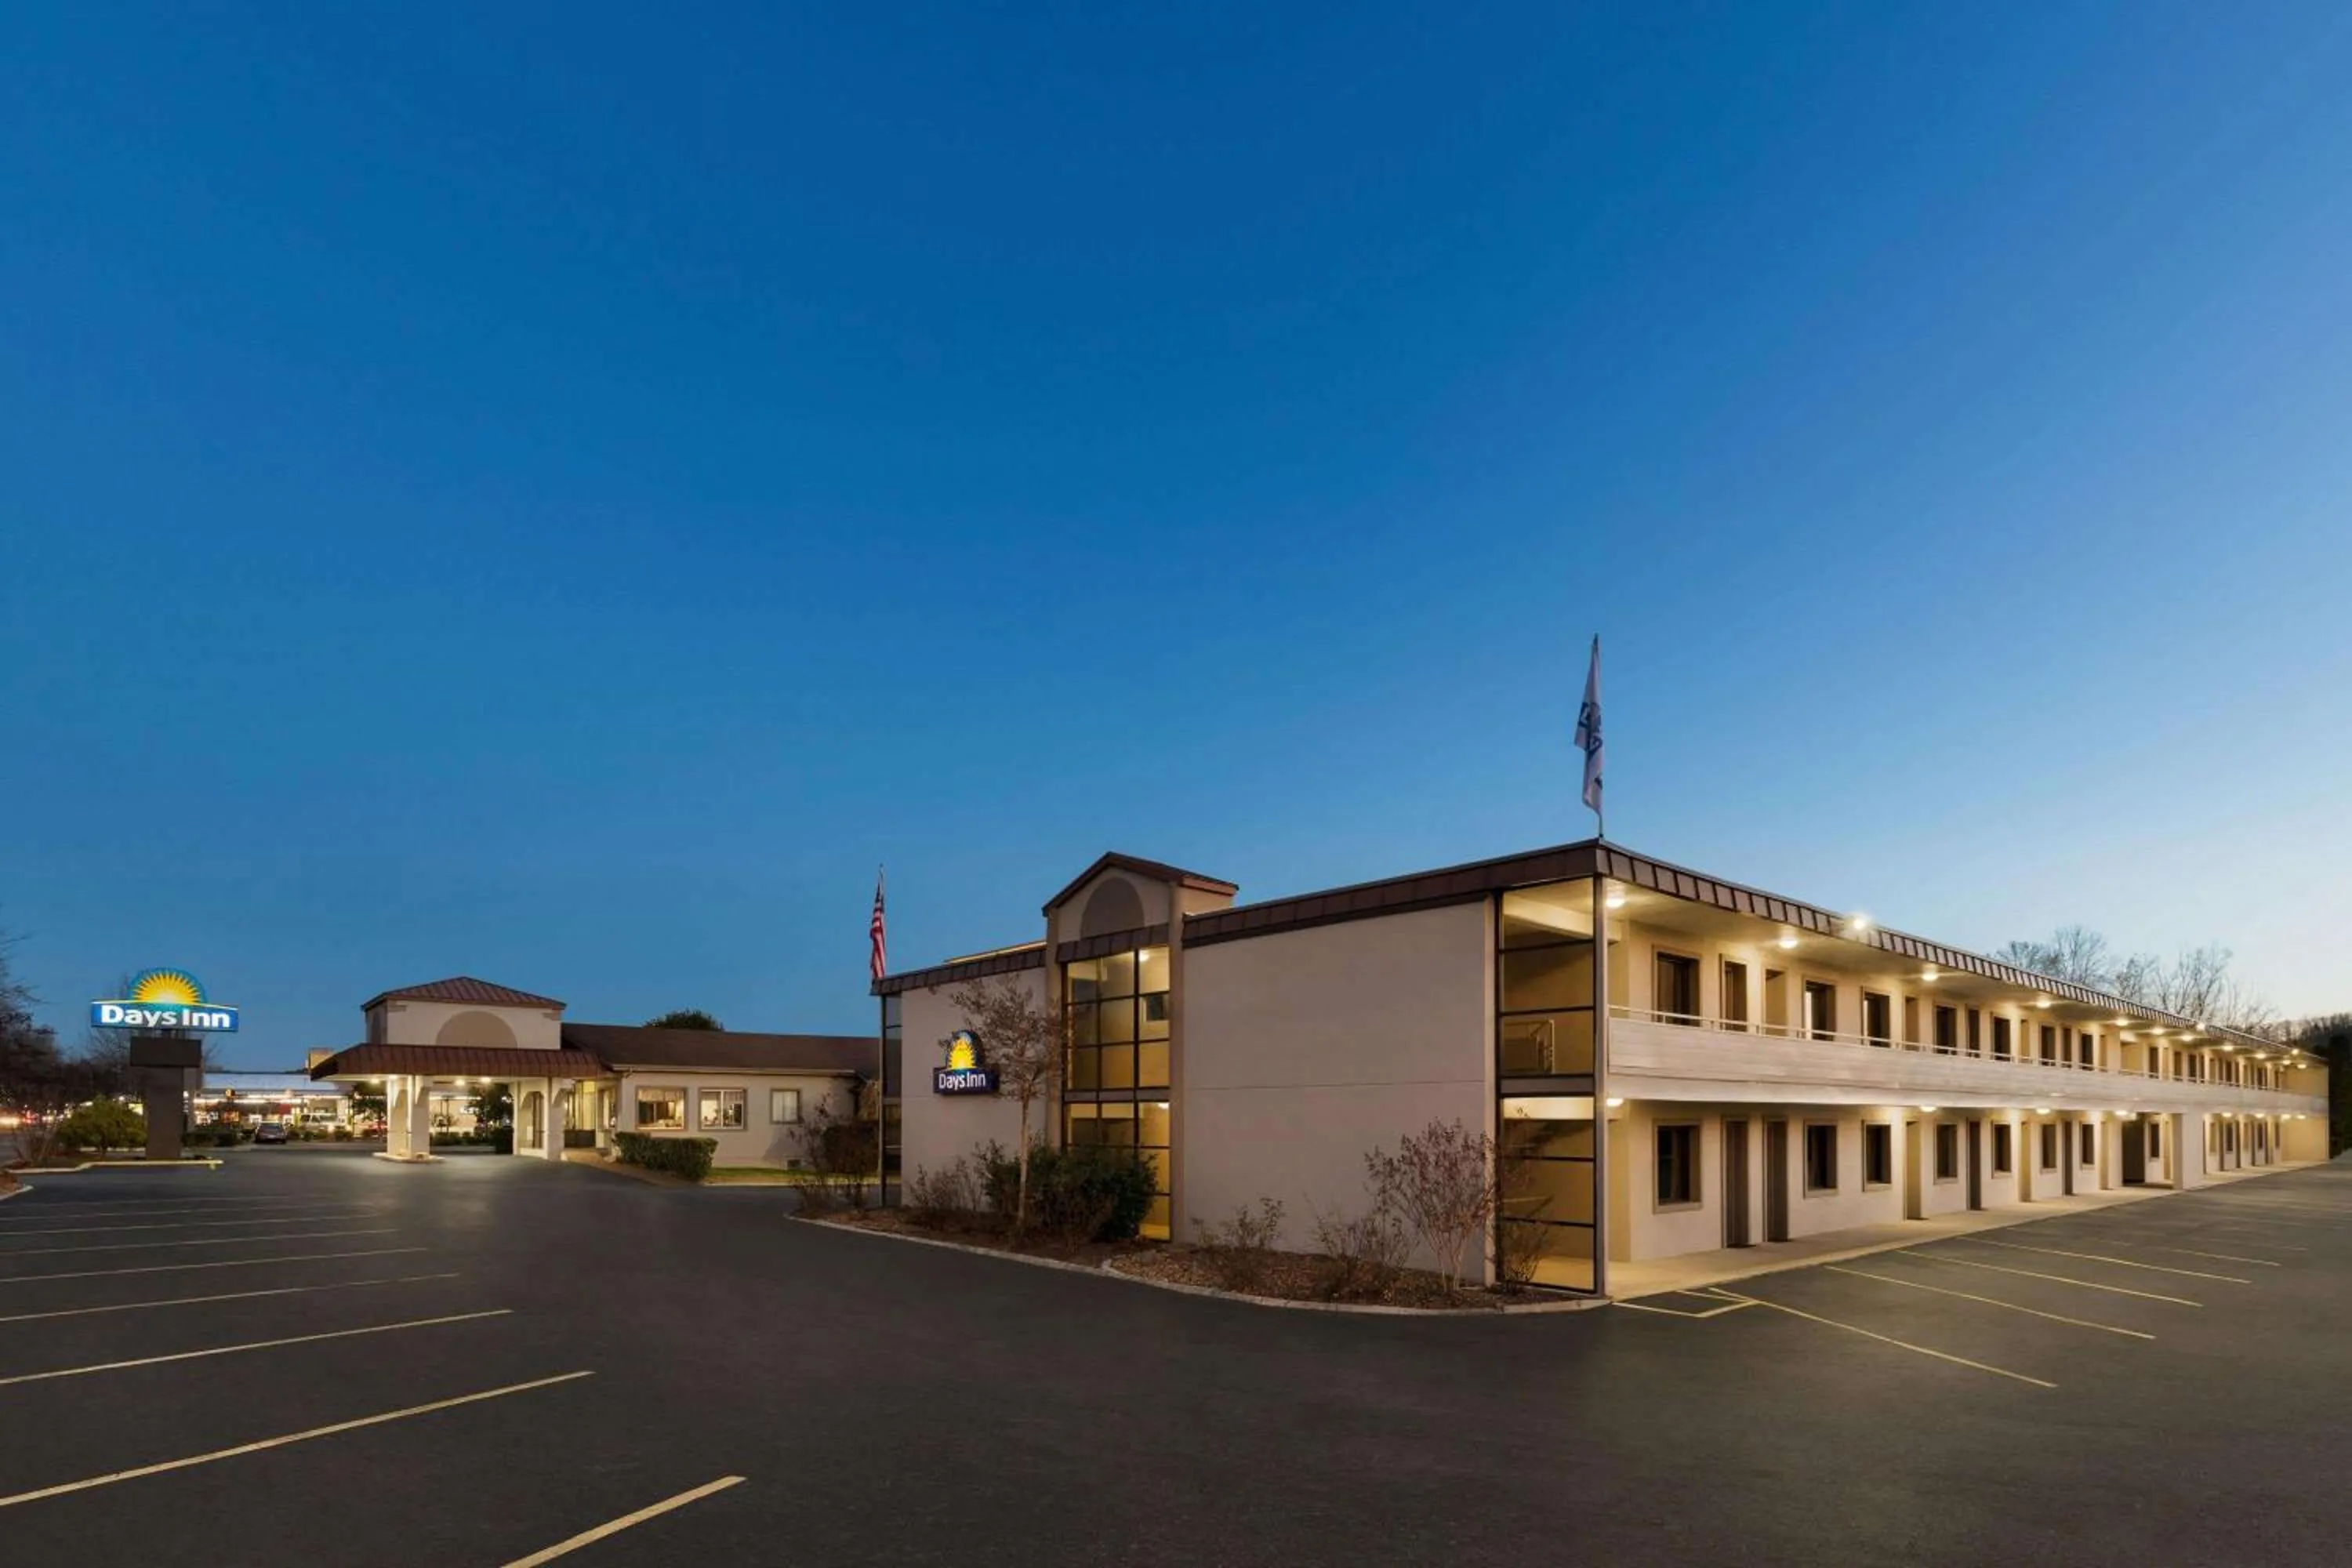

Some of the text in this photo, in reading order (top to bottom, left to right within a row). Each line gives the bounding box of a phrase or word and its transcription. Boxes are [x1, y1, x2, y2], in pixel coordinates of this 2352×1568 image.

[101, 1004, 230, 1027] Days Inn
[938, 1071, 985, 1091] Days Inn
